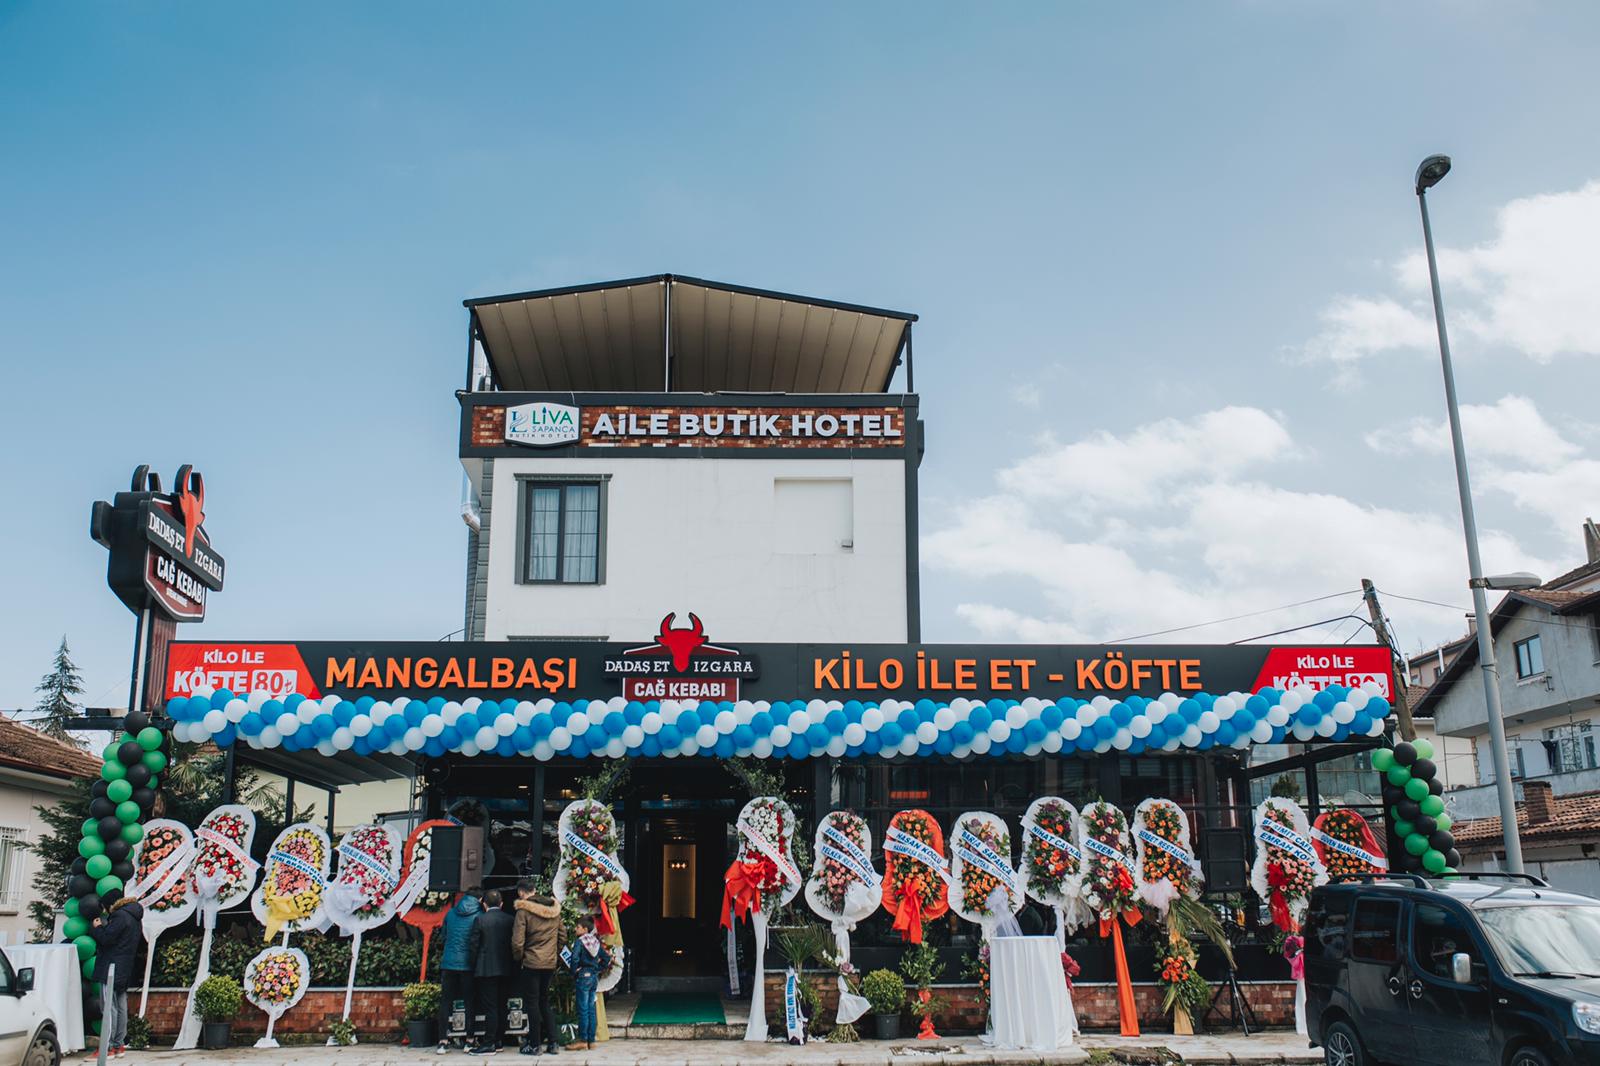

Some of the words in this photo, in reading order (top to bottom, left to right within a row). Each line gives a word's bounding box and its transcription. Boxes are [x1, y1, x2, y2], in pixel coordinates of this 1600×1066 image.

[531, 425, 575, 433] SAPANCA
[592, 413, 669, 435] AİLE
[679, 414, 781, 436] BUTİK
[792, 414, 901, 436] HOTEL
[148, 512, 175, 548] DADAŞ
[175, 533, 186, 553] ET
[194, 548, 222, 582] IZGARA
[176, 567, 205, 606] KEBABI
[203, 649, 239, 664] KİLO
[241, 649, 265, 664] İLE
[1297, 654, 1330, 669] KİLO
[1333, 654, 1355, 669] İLE
[325, 657, 577, 693] MANGALBAŞI
[604, 660, 650, 674] DADAŞ
[653, 660, 671, 672] ET
[693, 660, 754, 673] IZGARA
[813, 650, 904, 690] KİLO
[916, 650, 978, 690] İLE
[989, 659, 1037, 690] ET
[1076, 651, 1203, 690] KÖFTE
[173, 667, 249, 693] KÖFTE
[669, 682, 726, 697] KEBABI
[896, 832, 921, 849] HASAN
[1085, 839, 1114, 857] EKREM
[1260, 832, 1294, 851] EMRAH
[598, 855, 620, 874] GROUP
[982, 848, 1012, 875] SAPANCA
